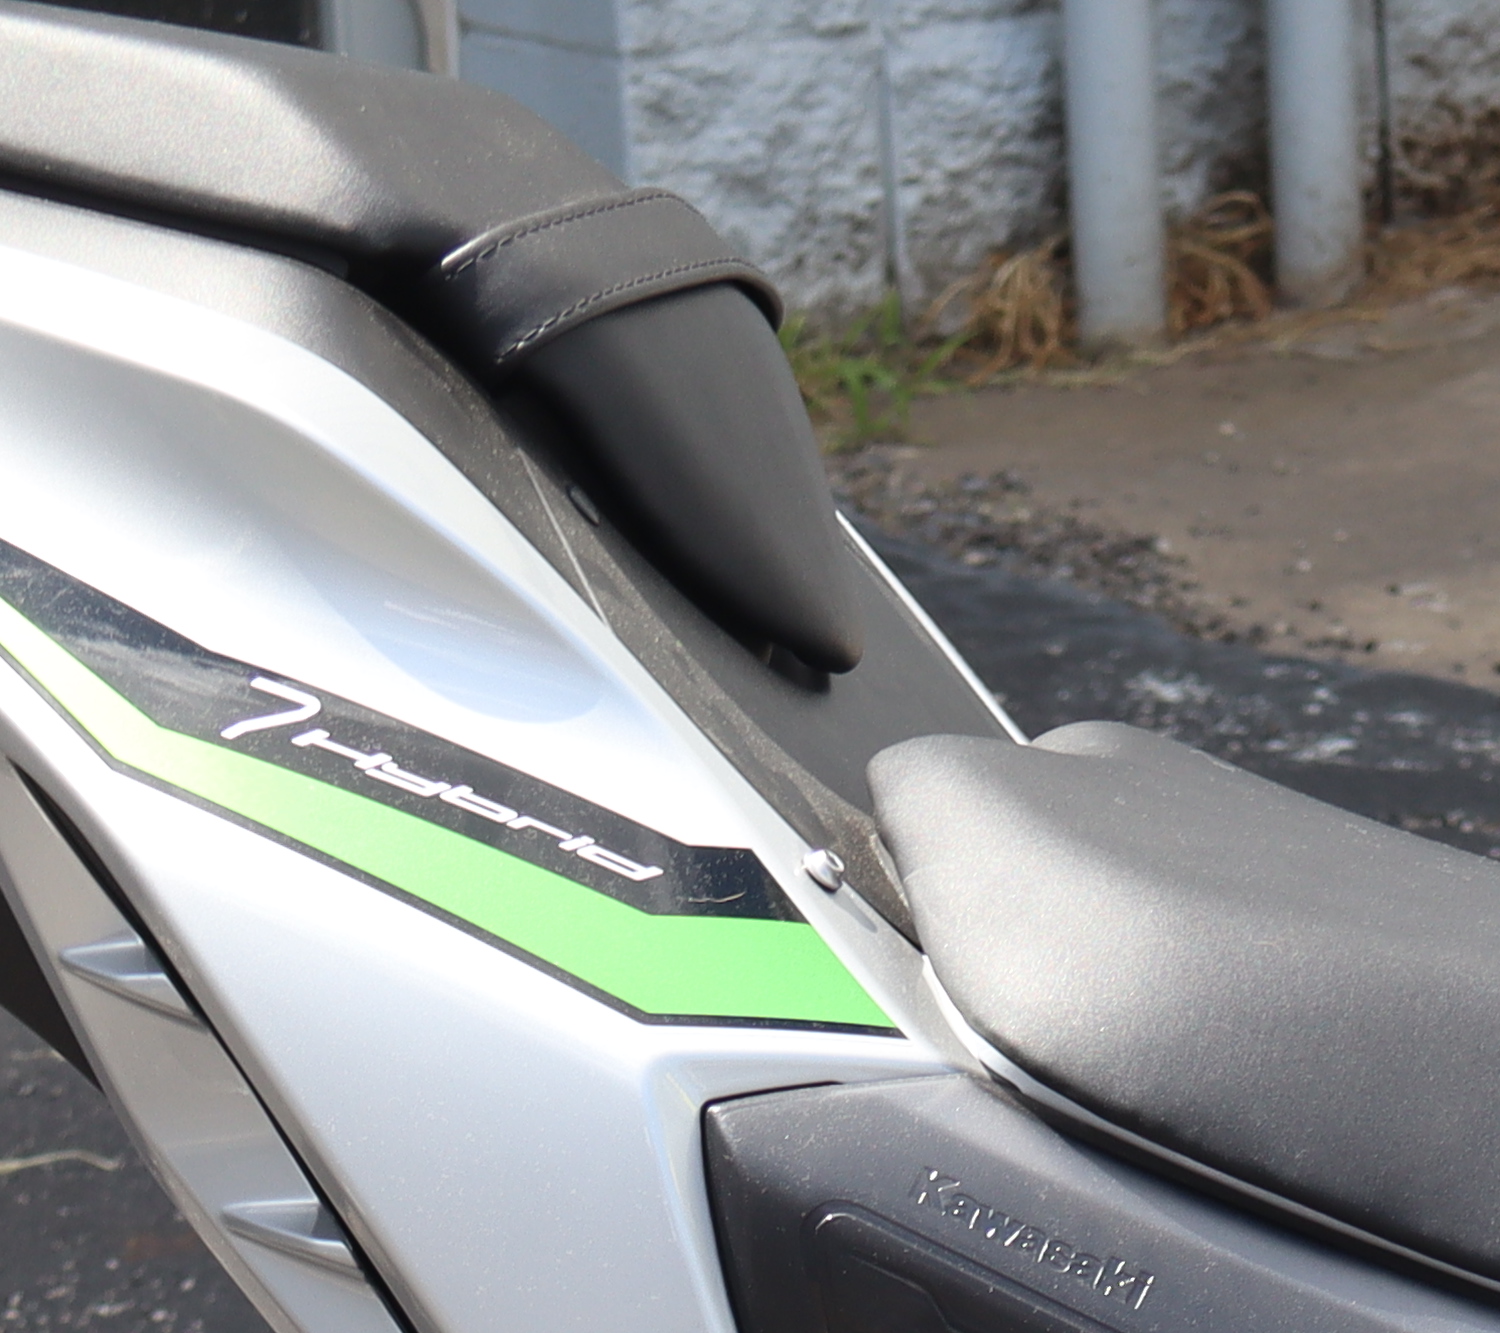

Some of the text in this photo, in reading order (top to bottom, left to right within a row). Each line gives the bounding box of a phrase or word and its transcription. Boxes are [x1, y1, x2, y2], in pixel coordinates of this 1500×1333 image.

[219, 675, 665, 882] 7 Hybrid
[907, 1165, 1155, 1310] Kawasaki
